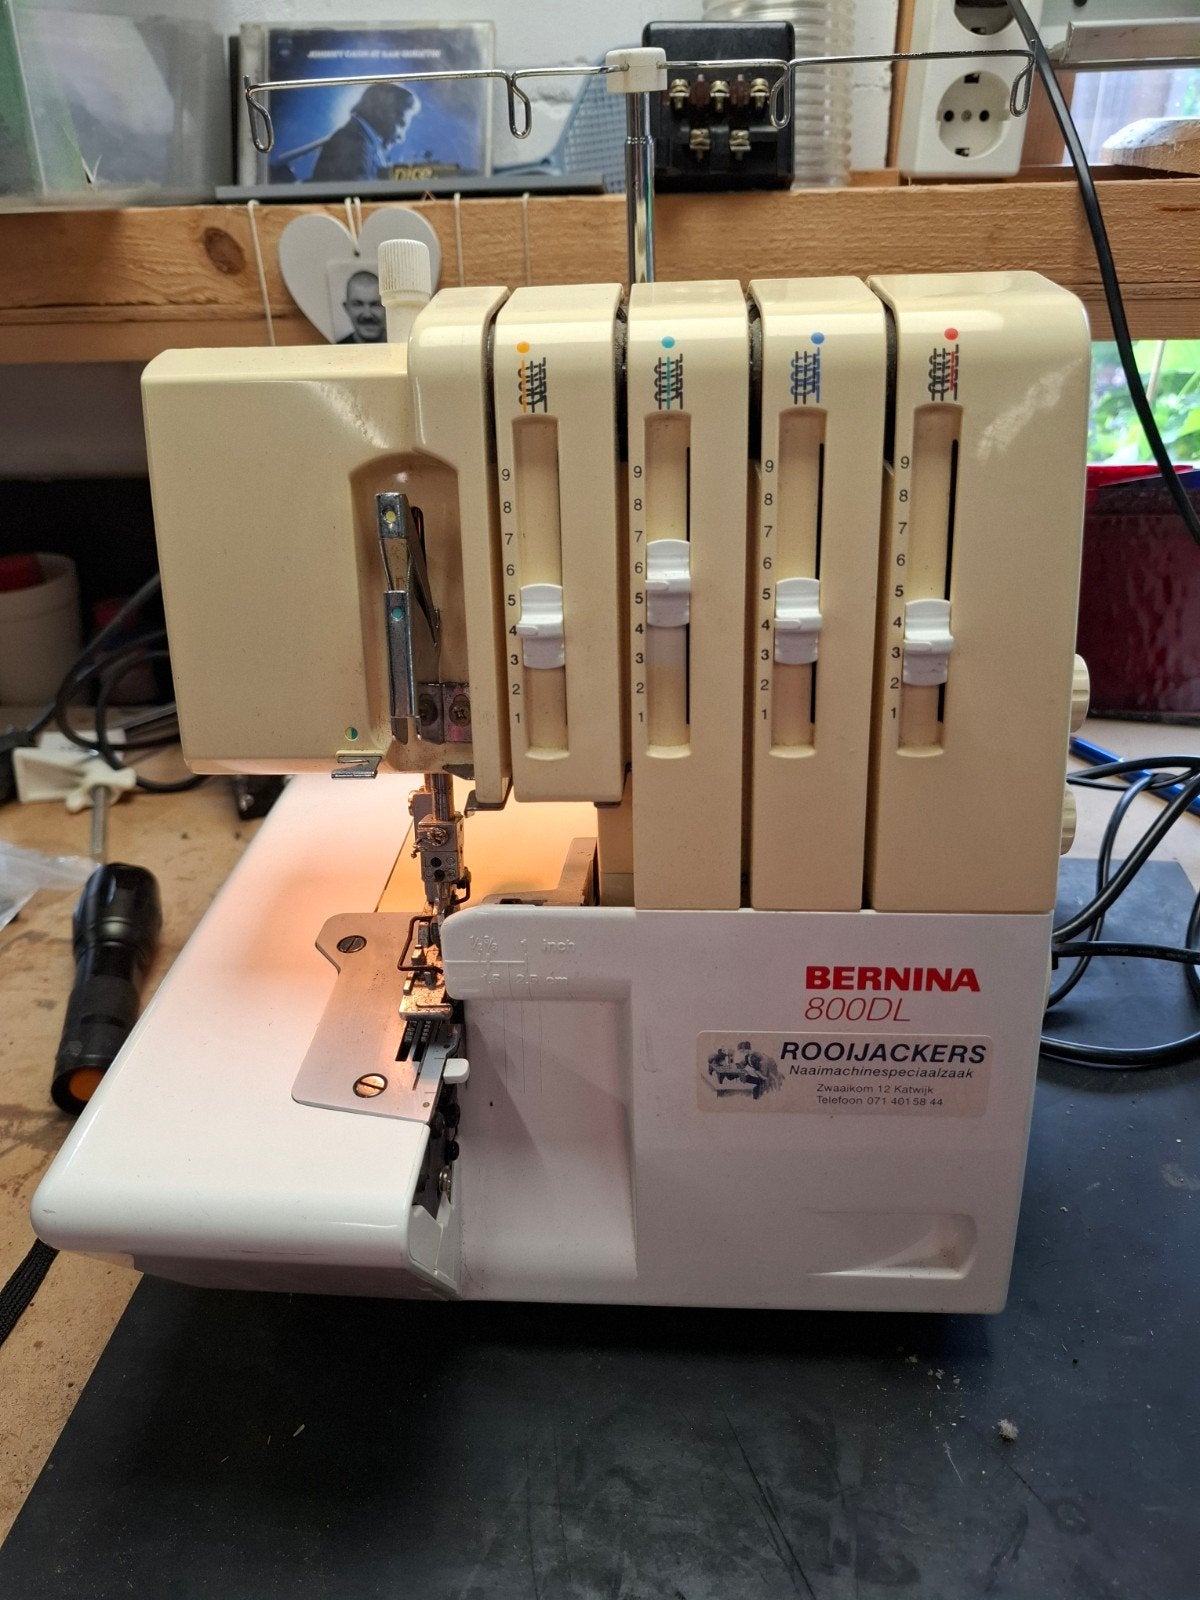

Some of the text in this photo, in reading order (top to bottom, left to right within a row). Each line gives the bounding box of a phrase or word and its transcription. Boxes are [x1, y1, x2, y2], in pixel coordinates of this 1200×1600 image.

[765, 459, 775, 474] 9
[901, 455, 910, 470] 9
[502, 468, 511, 482] 9
[634, 465, 643, 479] 9
[764, 492, 774, 506] 8
[899, 488, 909, 503] 8
[503, 500, 512, 514] 8
[634, 497, 643, 512] 8
[764, 525, 773, 538] 7
[899, 521, 908, 535] 7
[505, 532, 514, 546] 7
[634, 530, 644, 543] 7
[763, 556, 772, 570] 6
[897, 553, 906, 567] 6
[506, 563, 515, 577] 6
[635, 561, 644, 575] 6
[635, 591, 644, 605] 5
[762, 587, 772, 601] 5
[895, 584, 905, 598] 5
[508, 593, 517, 607] 5
[635, 622, 645, 635] 4
[762, 618, 771, 631] 4
[893, 616, 903, 629] 4
[509, 624, 518, 637] 4
[511, 653, 520, 666] 3
[636, 652, 645, 665] 3
[761, 648, 770, 661] 3
[891, 646, 901, 659] 3
[513, 683, 521, 696] 2
[637, 681, 645, 694] 2
[761, 678, 770, 691] 2
[890, 676, 900, 690] 2
[541, 939, 577, 953] inch
[546, 976, 569, 986] cm
[805, 965, 981, 993] BERNINA
[804, 997, 911, 1022] 800DL
[780, 1041, 987, 1064] ROOIJACKERS
[789, 1065, 974, 1079] Naaimachinespeciaalzaak
[816, 1083, 934, 1096] Zwaaikom 12 Katwijk
[816, 1096, 863, 1105] Telefoon
[867, 1097, 886, 1105] 071
